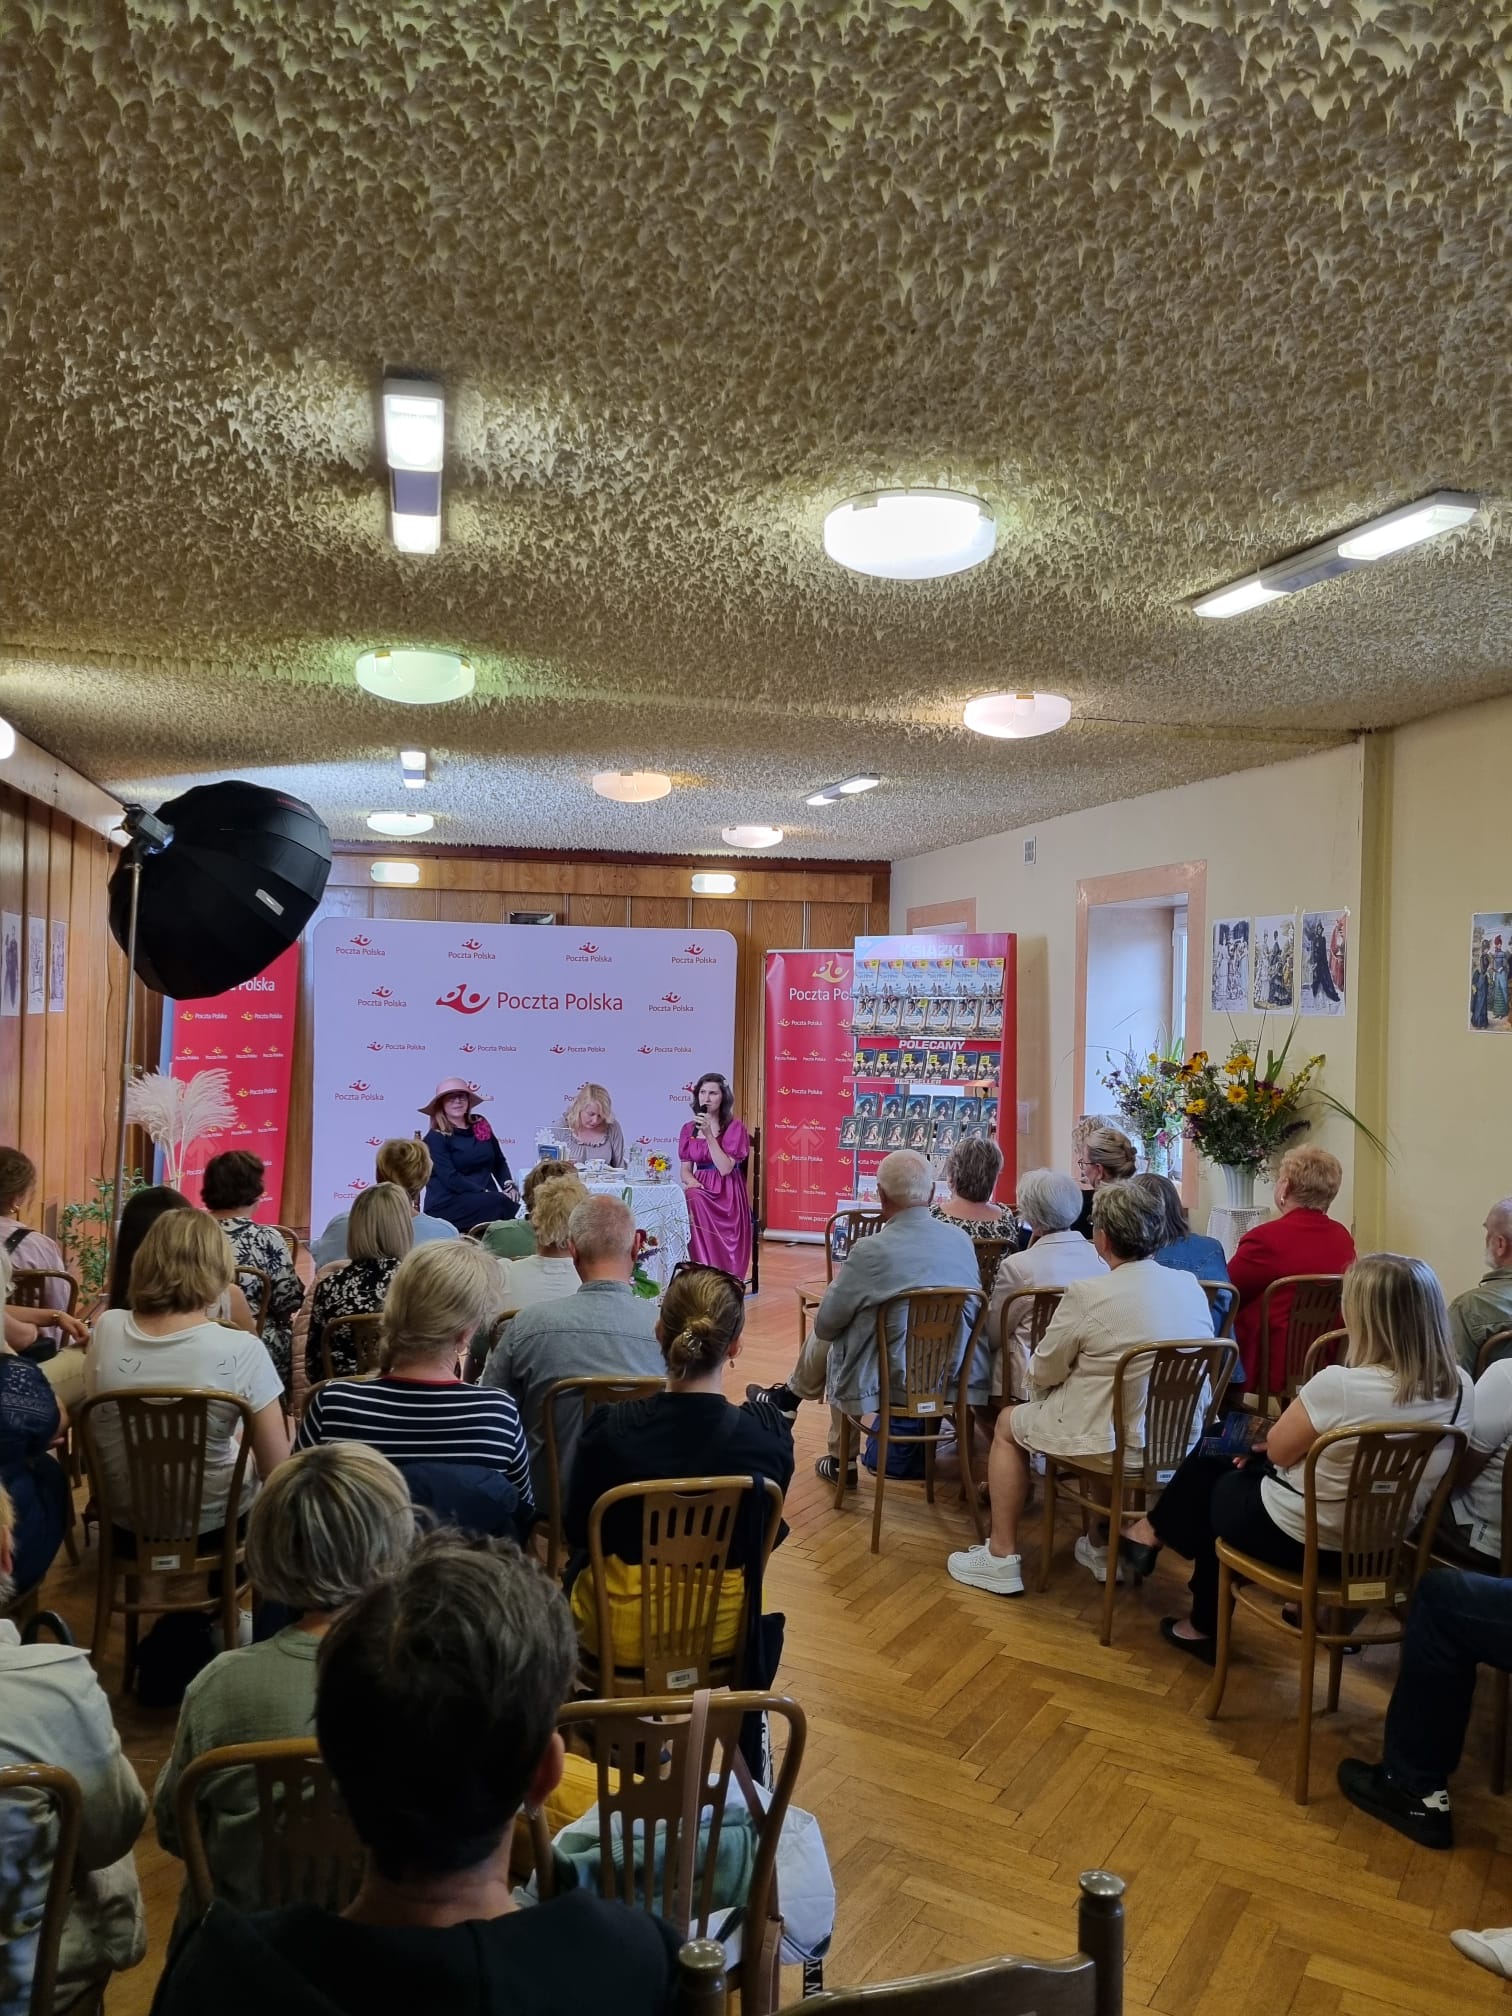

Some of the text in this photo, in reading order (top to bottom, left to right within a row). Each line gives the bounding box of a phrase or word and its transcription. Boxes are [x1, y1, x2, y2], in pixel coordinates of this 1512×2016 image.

[336, 947, 386, 956] Poczta Polska
[474, 952, 496, 960] Polska
[790, 988, 852, 1000] Poczta Pol
[384, 999, 406, 1007] Polska
[498, 992, 623, 1010] Poczta Polska
[898, 1040, 965, 1050] POLECAMY
